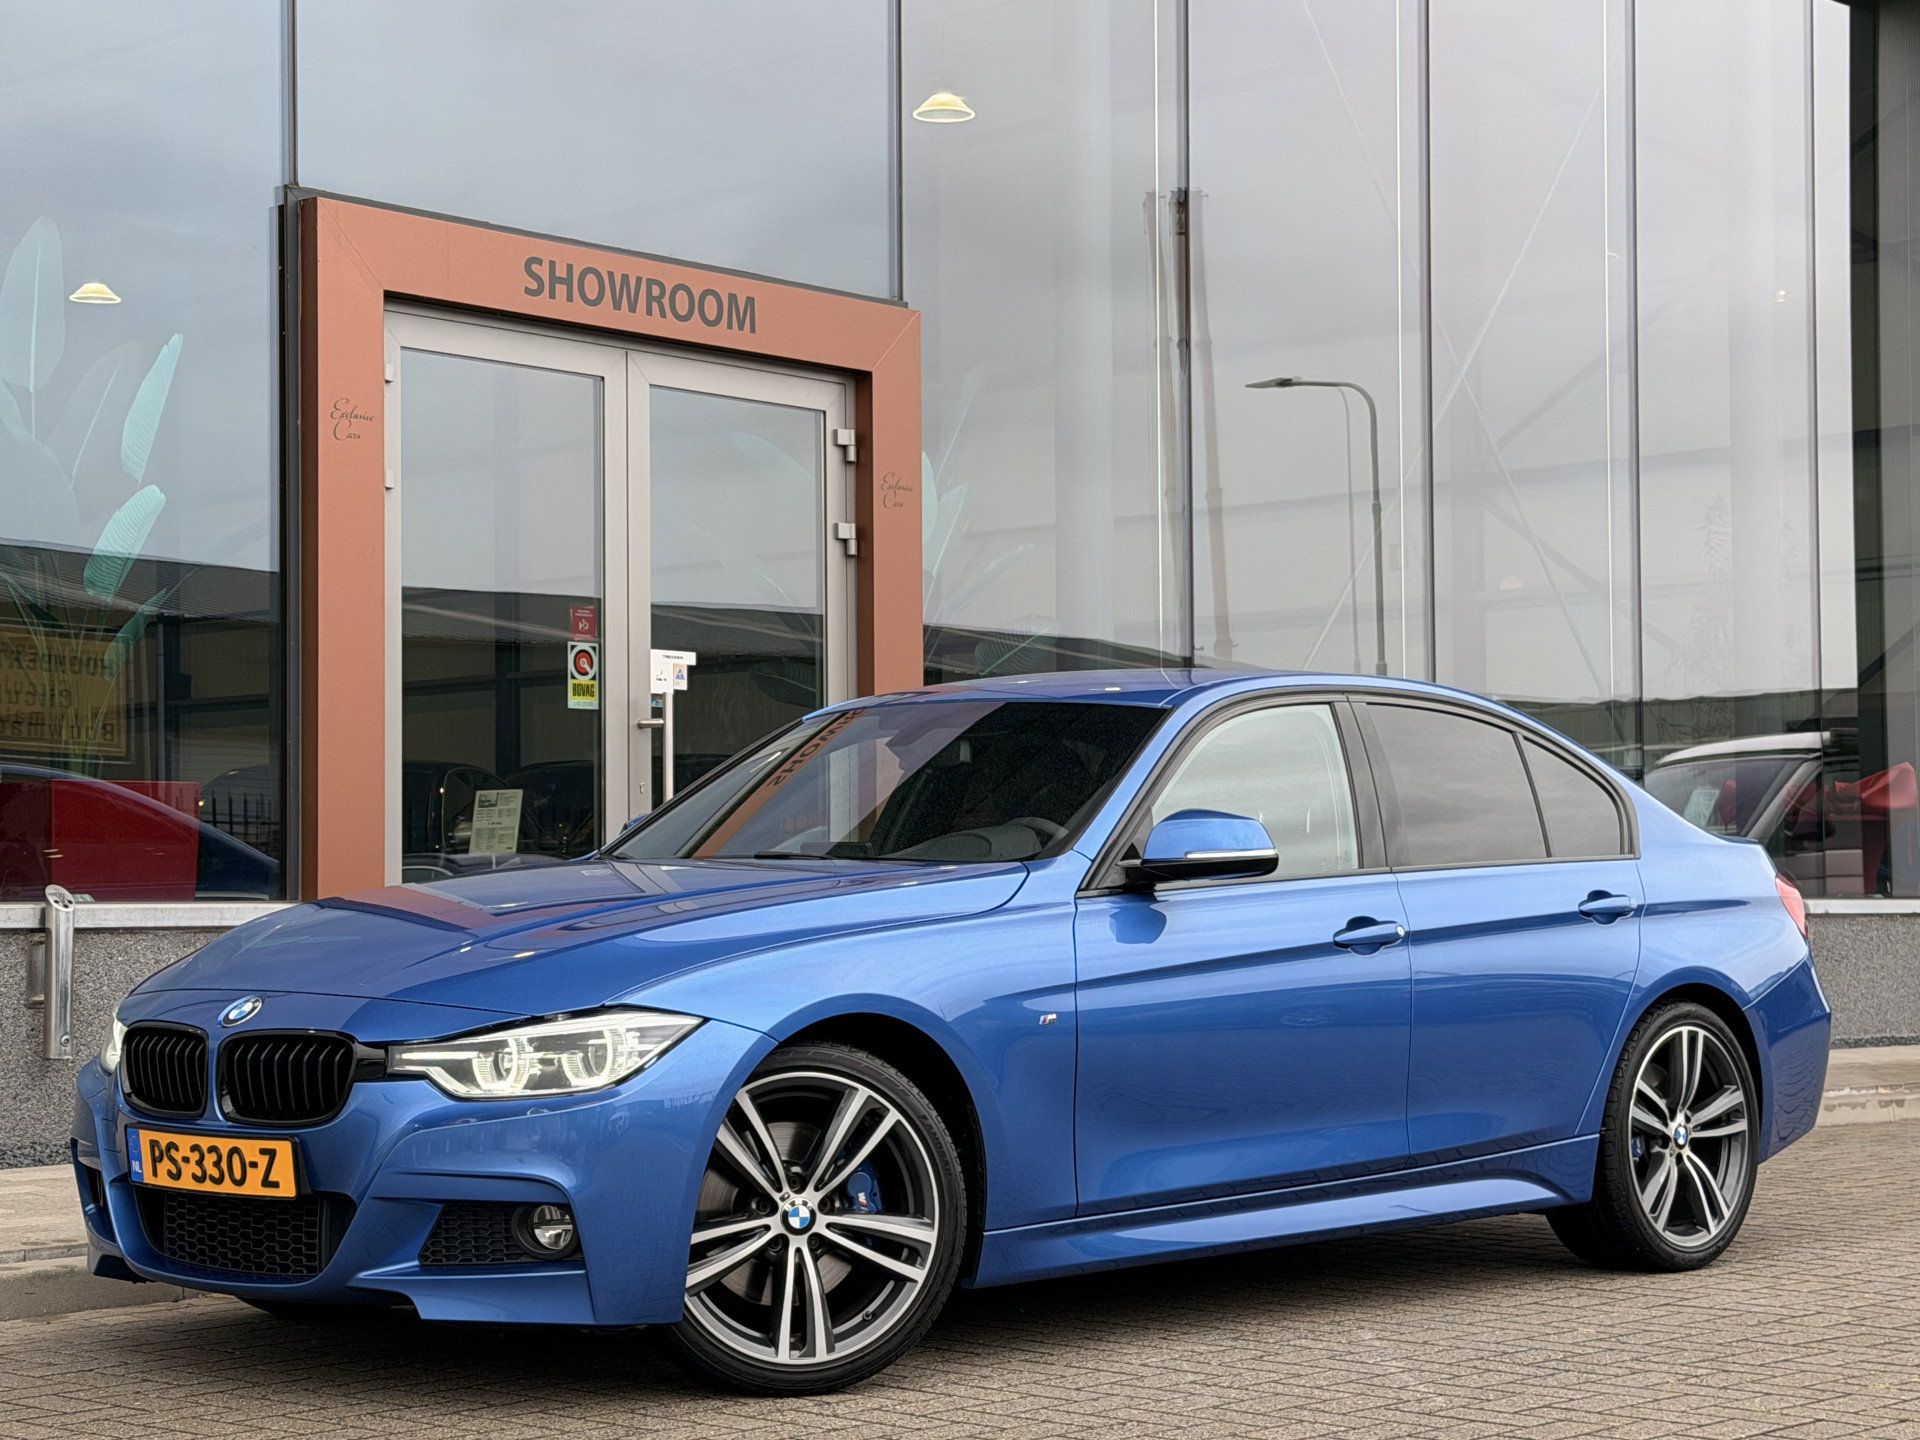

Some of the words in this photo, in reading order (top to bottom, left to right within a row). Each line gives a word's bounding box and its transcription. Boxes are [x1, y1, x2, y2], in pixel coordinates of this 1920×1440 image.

[523, 256, 757, 335] SHOWROOM
[572, 683, 595, 698] BOVAG
[131, 1160, 143, 1173] NL
[148, 1138, 281, 1189] PS-330-Z
